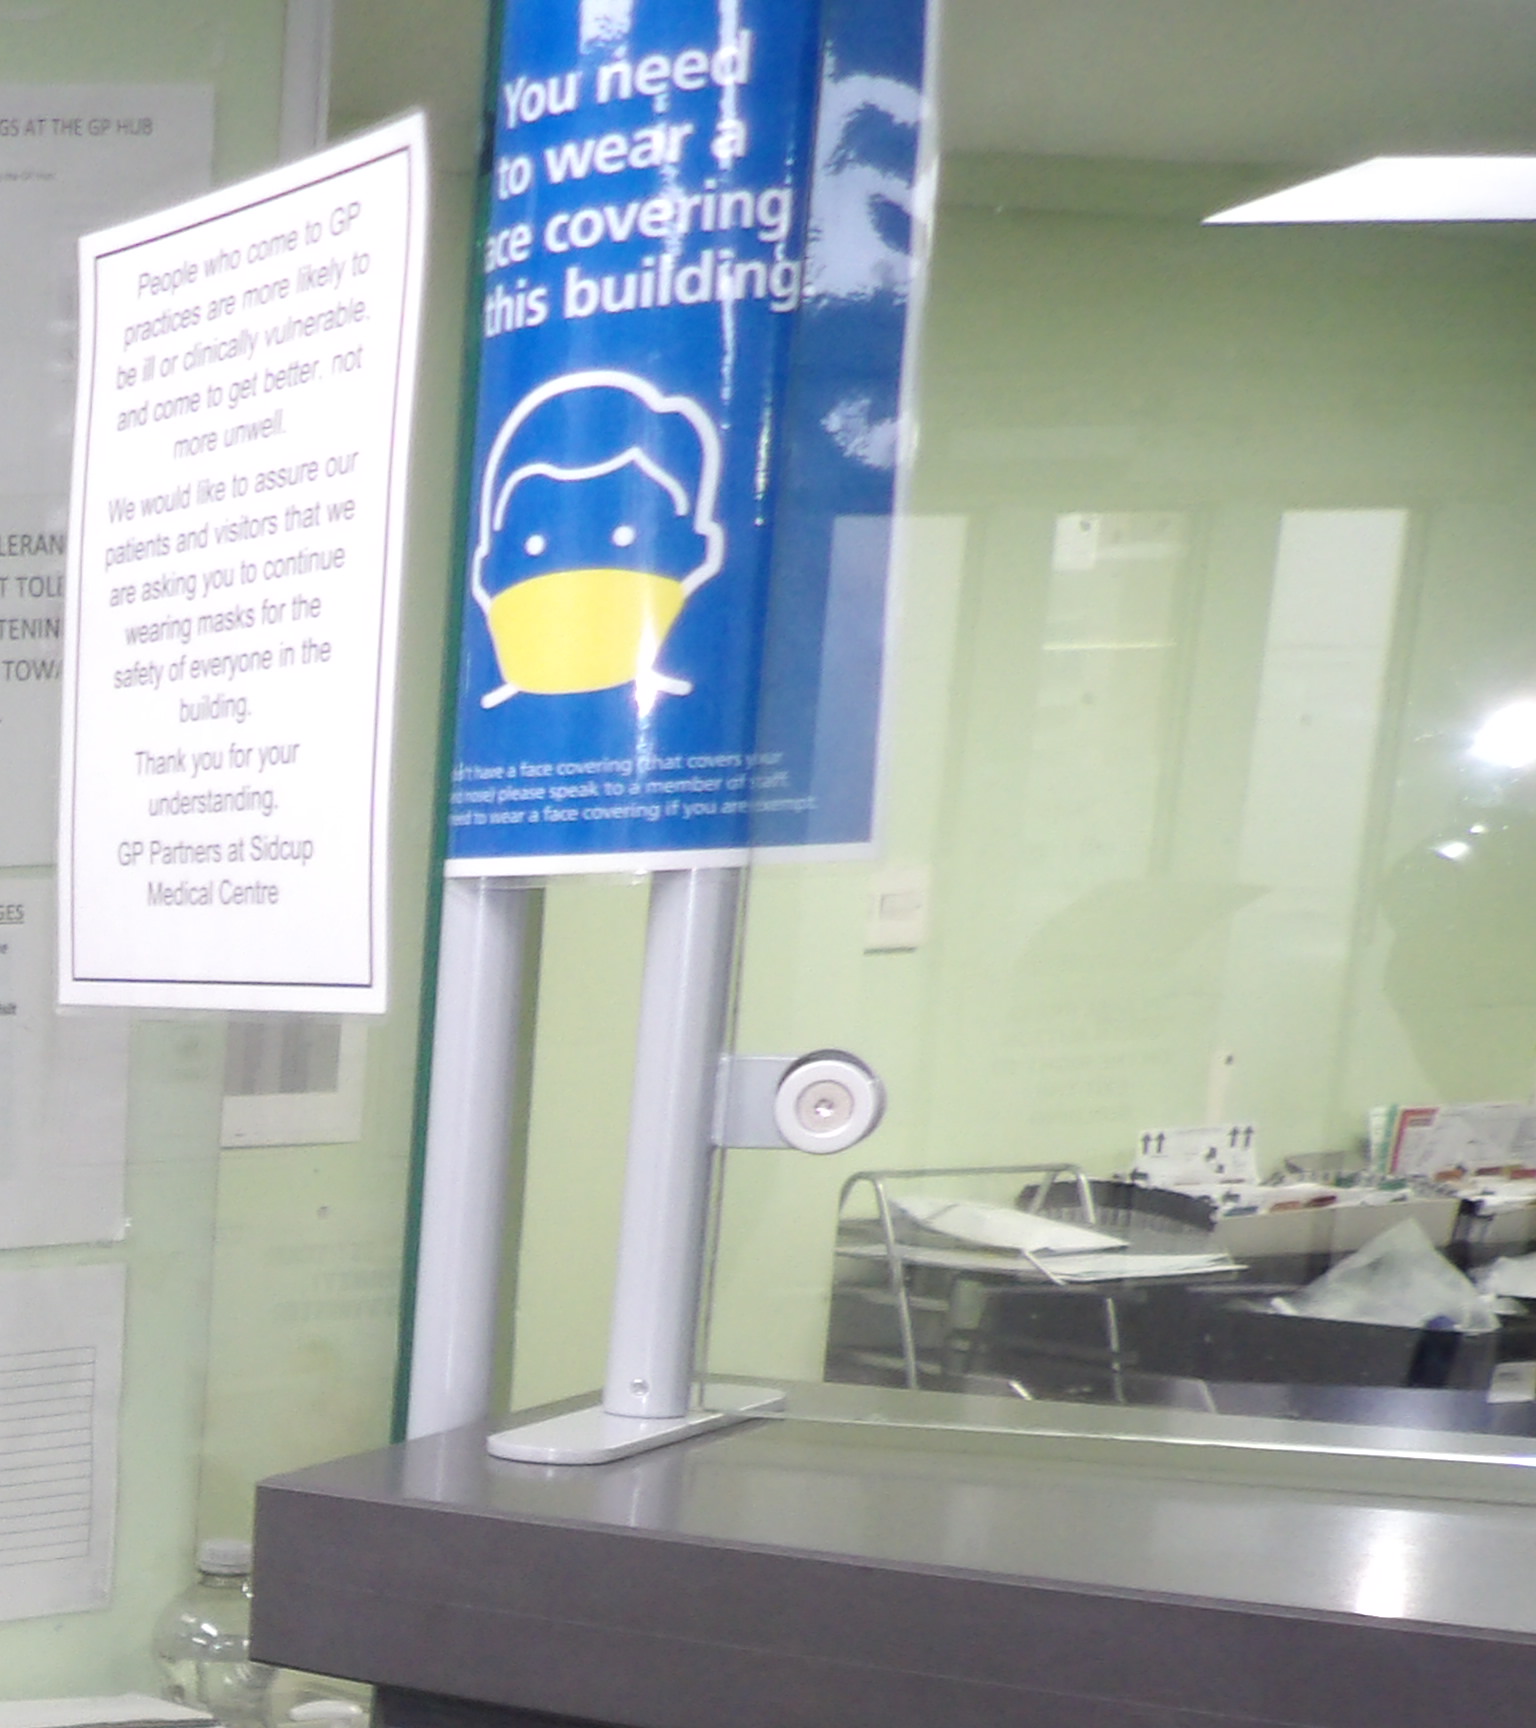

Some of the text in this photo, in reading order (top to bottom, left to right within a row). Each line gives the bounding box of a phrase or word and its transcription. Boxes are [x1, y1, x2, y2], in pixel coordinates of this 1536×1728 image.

[503, 28, 754, 129] You need
[24, 119, 46, 135] AT
[52, 119, 81, 136] THE
[89, 119, 110, 135] GP
[117, 118, 152, 135] HUB
[497, 117, 746, 200] to wear a
[137, 201, 361, 299] People who come to GP
[485, 178, 792, 273] ace covering
[124, 251, 370, 350] practices are more likely to
[485, 248, 817, 338] this building.
[549, 781, 598, 800] speak
[605, 780, 624, 796] to
[629, 782, 640, 795] a
[646, 775, 723, 794] member
[118, 836, 314, 866] GP Partners at Sidcup
[147, 880, 278, 906] Medical Centre
